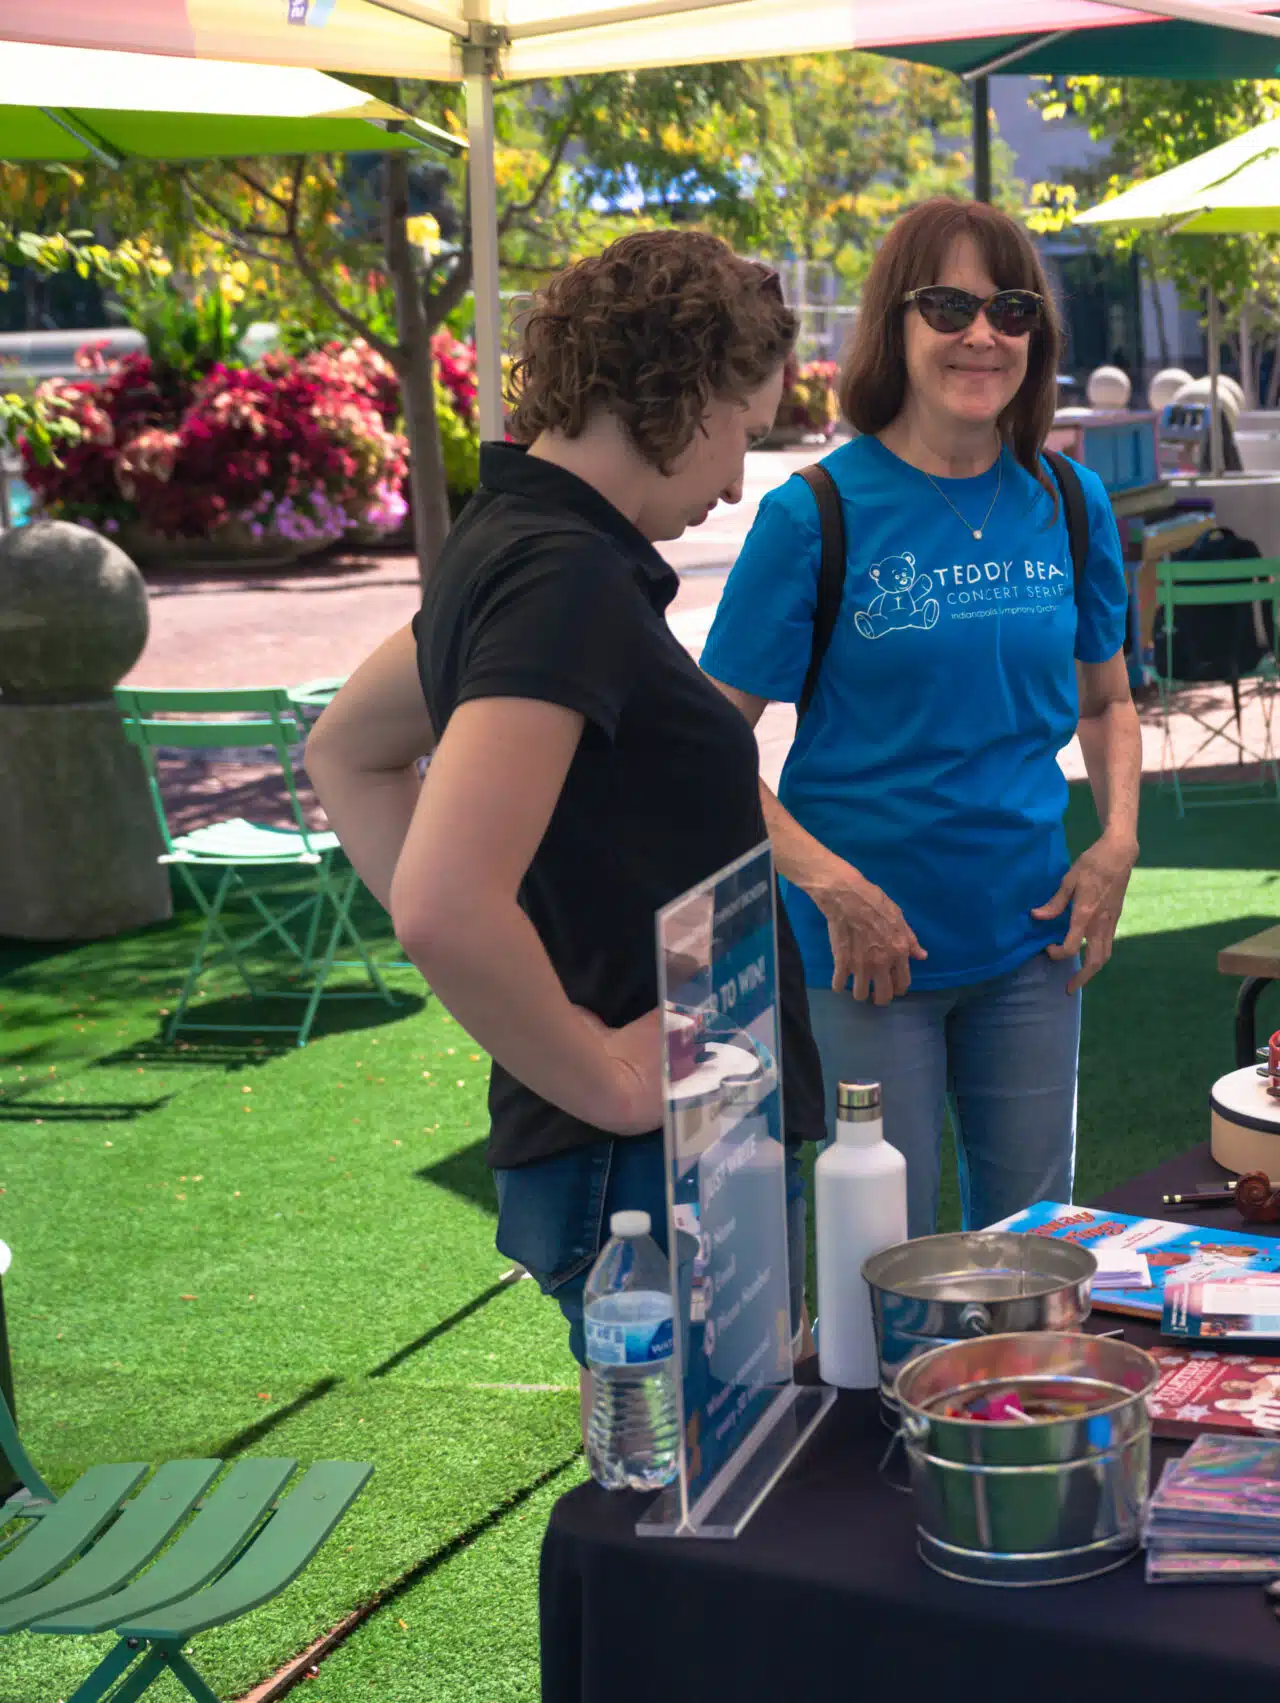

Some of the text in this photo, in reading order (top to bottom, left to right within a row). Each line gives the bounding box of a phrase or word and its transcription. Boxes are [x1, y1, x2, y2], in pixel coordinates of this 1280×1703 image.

[933, 560, 1068, 587] TEDDY BEA
[946, 586, 1018, 605] CONCERT
[999, 604, 1035, 616] ymphony
